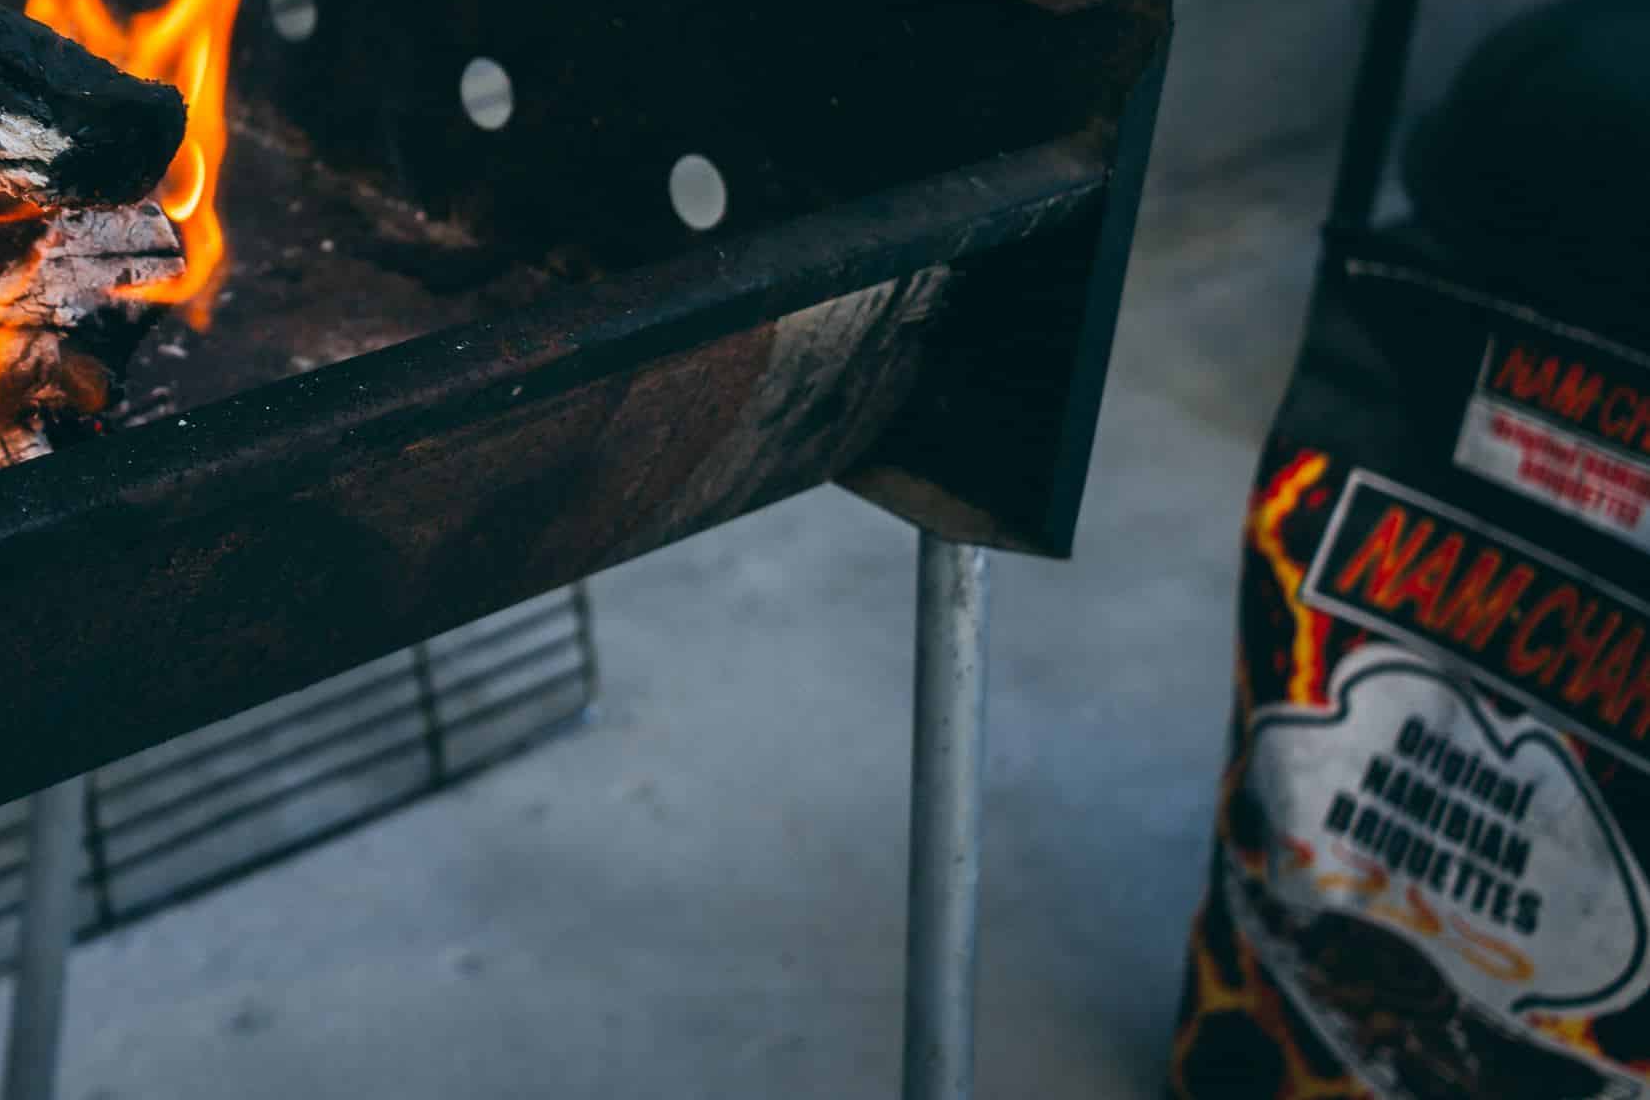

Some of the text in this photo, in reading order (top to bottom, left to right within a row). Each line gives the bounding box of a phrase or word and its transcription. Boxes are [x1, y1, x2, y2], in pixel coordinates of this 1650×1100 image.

[1362, 755, 1532, 879] NAMIBIAN
[1397, 717, 1536, 823] Original
[1325, 790, 1543, 935] BRIQUETTES
